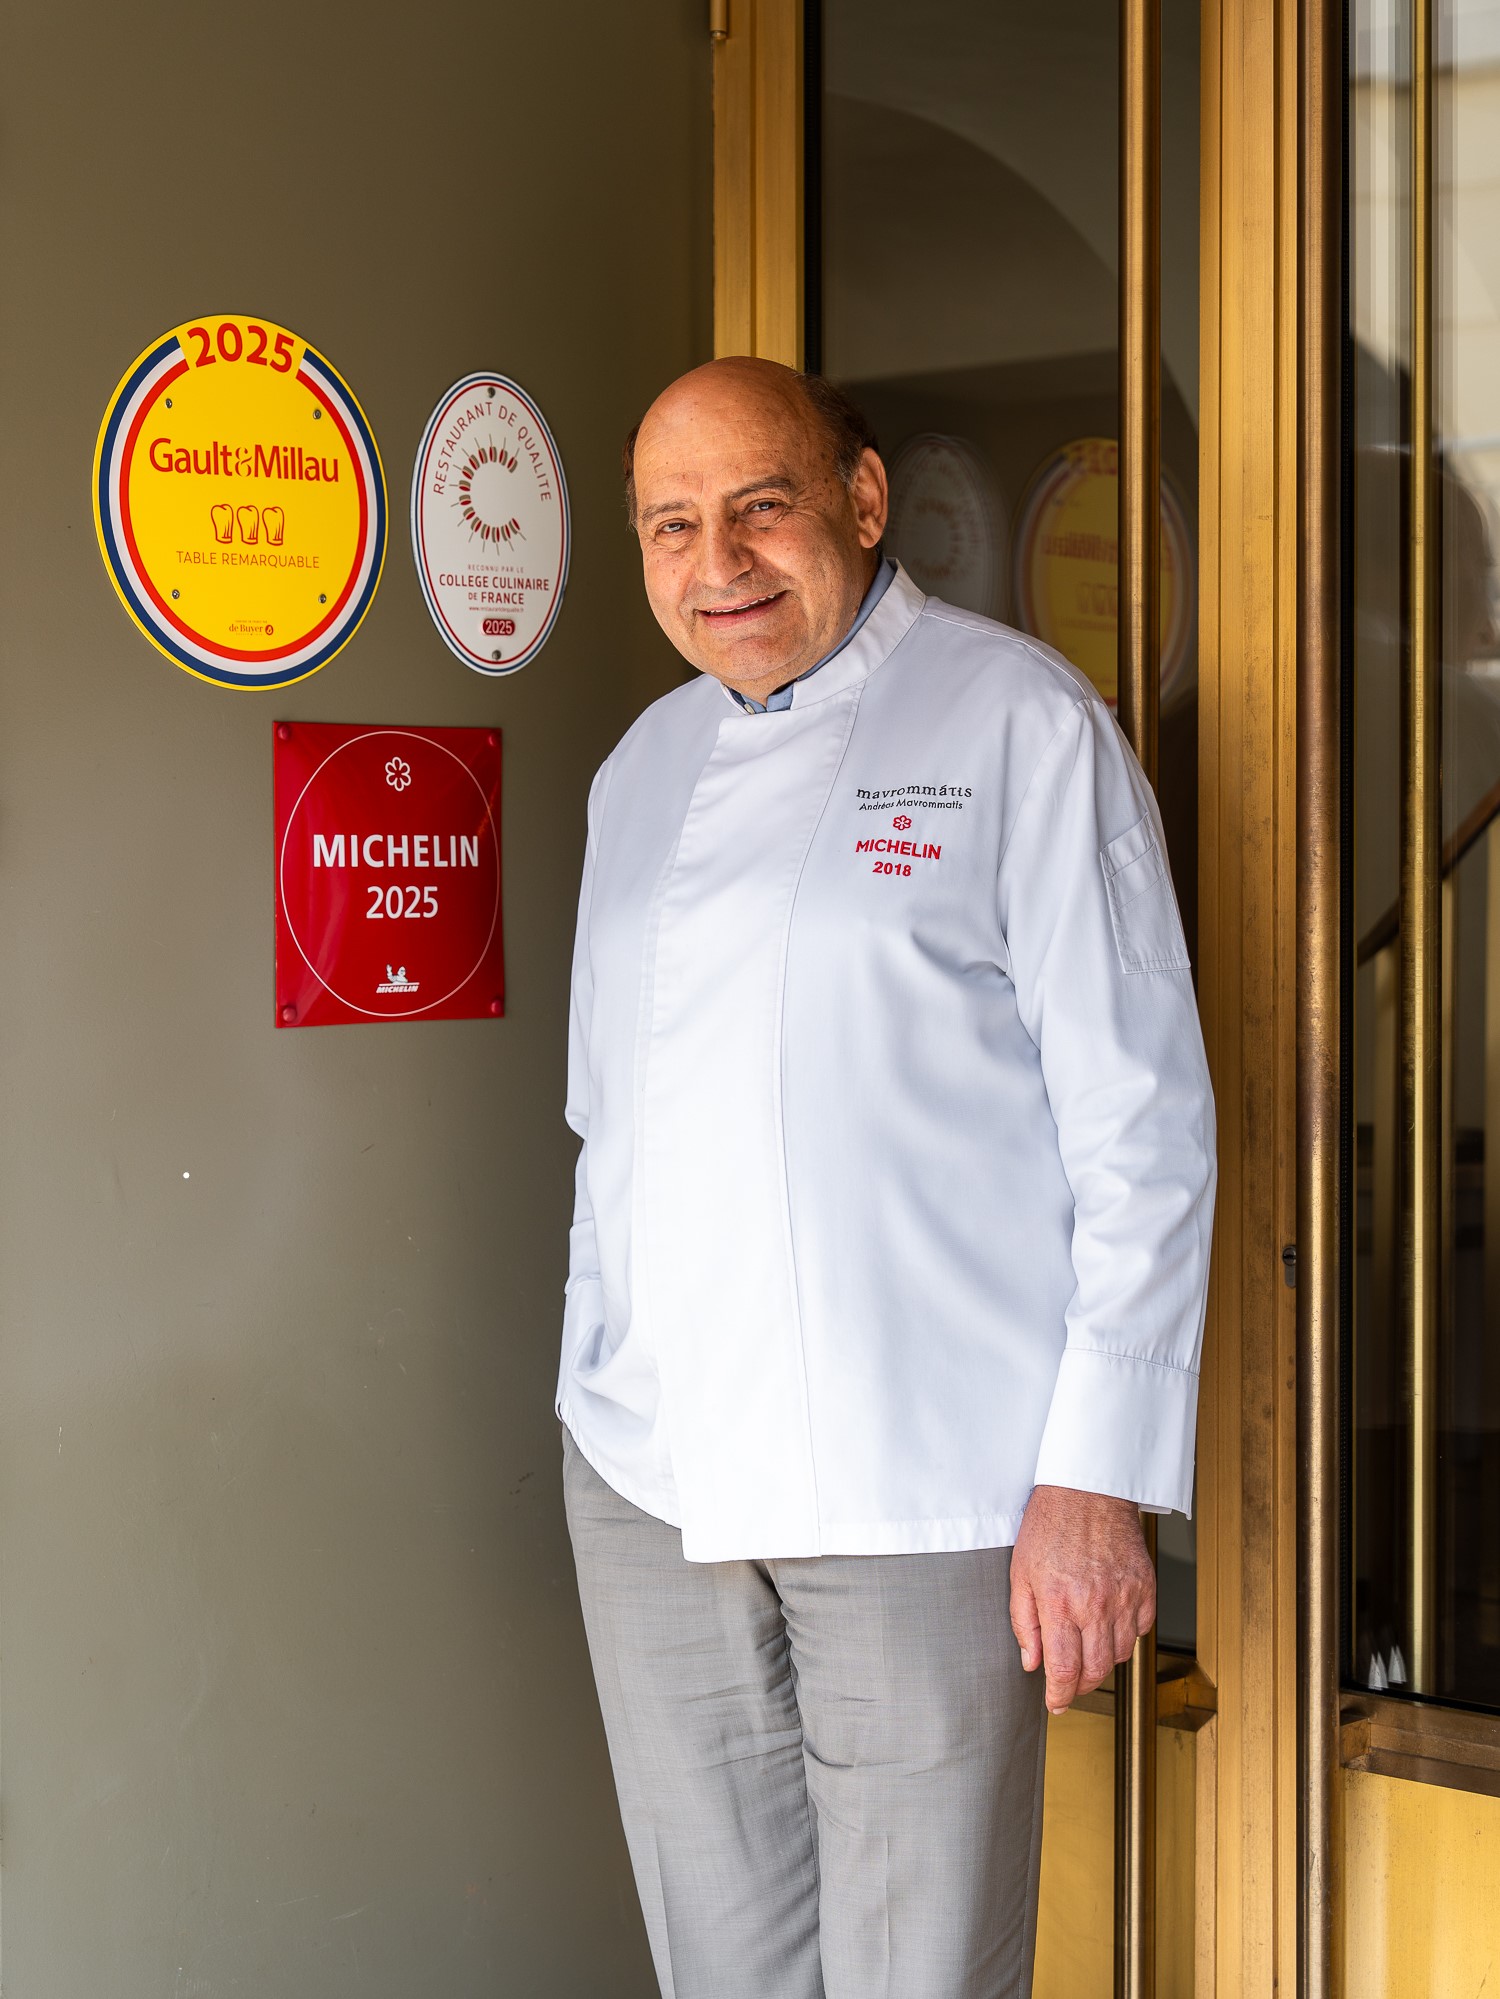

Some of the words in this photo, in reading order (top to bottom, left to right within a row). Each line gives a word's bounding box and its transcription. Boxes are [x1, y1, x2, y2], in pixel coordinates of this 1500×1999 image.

[187, 322, 295, 373] 2025
[149, 437, 340, 482] Gault&Millau
[433, 402, 492, 495] RESTAURANT
[498, 405, 518, 427] DE
[518, 426, 552, 502] QUALITE
[176, 550, 218, 565] TABLE
[222, 552, 320, 569] REMARQUABLE
[468, 564, 499, 572] RECONNU
[501, 565, 514, 573] PAR
[516, 566, 524, 574] LE
[439, 573, 489, 588] COLLEGE
[492, 576, 550, 591] CULINAIRE
[468, 592, 477, 600] DE
[481, 591, 525, 605] FRANCE
[485, 620, 513, 634] 2025
[896, 798, 963, 810] Mavrommatis
[313, 834, 479, 868] MICHELIN
[855, 838, 942, 860] MICHELIN
[872, 861, 912, 877] 2018
[366, 885, 439, 919] 2025
[376, 985, 419, 994] MICHELIN
